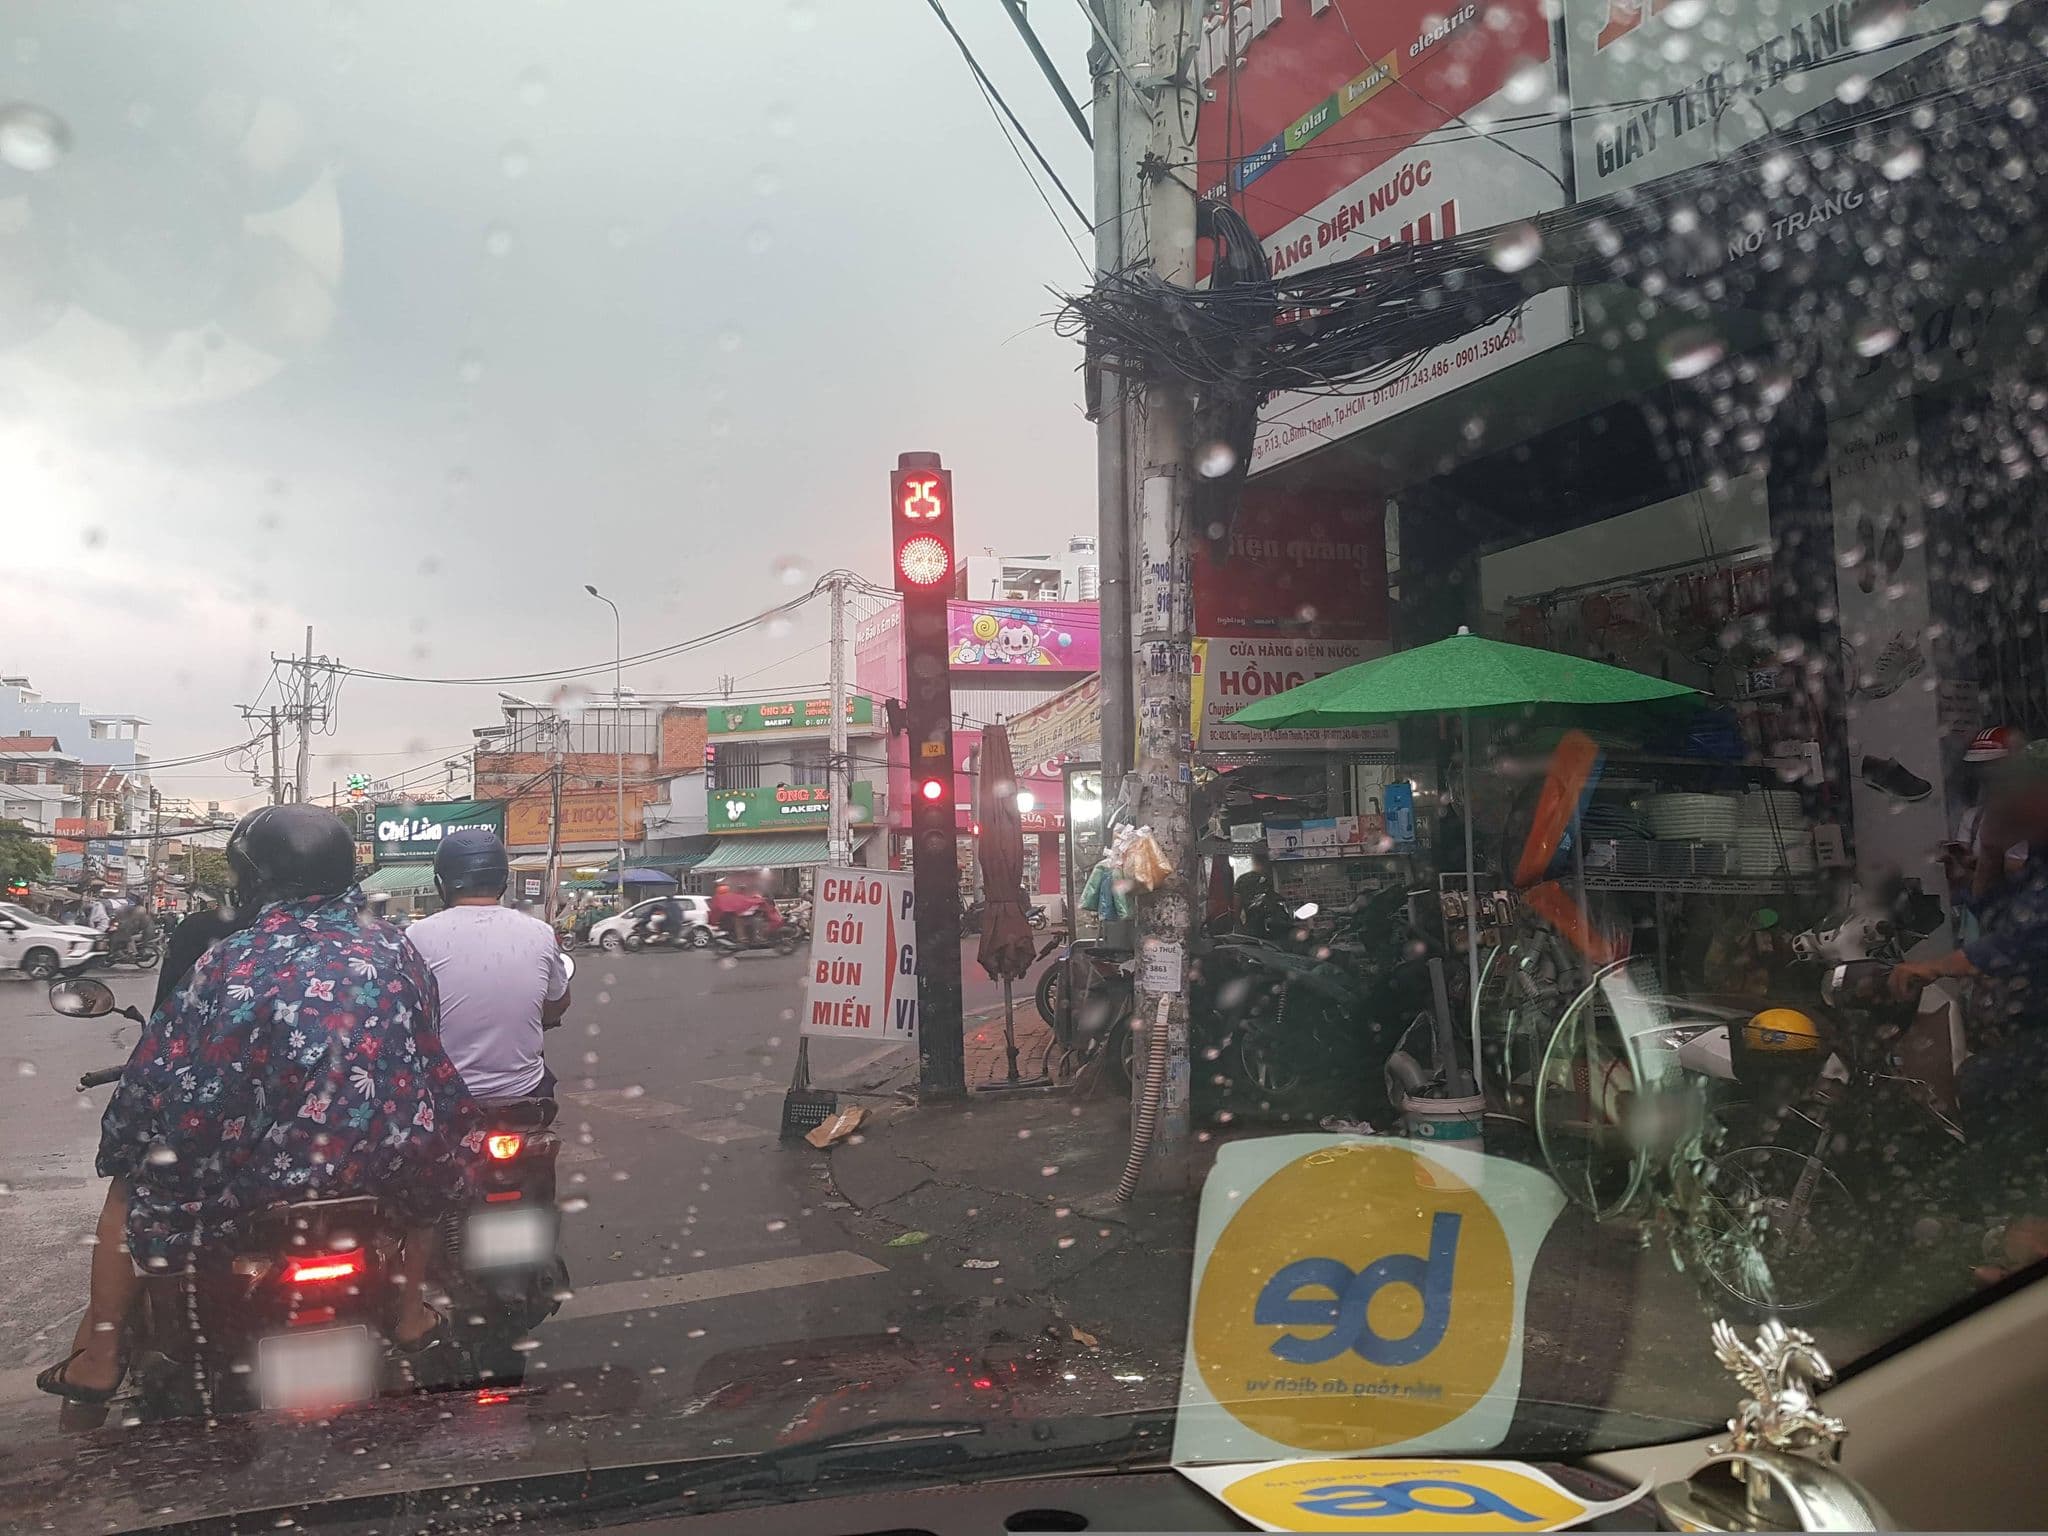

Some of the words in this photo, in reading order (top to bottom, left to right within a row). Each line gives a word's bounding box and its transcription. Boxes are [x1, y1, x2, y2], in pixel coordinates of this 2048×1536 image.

[1409, 3, 1475, 57] electric
[1293, 106, 1328, 141] solar
[1316, 200, 1366, 249] ĐIỆN
[1369, 160, 1433, 218] NƯỚC
[1772, 191, 1864, 241] TRANG
[1334, 397, 1366, 423] Tp.HCM
[1390, 358, 1449, 398] 0777.243.486
[904, 481, 941, 519] 25
[1258, 643, 1293, 657] HÀNG
[775, 787, 810, 803] ÔNG
[813, 788, 832, 801] X
[781, 804, 830, 814] BAKERY
[823, 876, 883, 906] CHÁO
[901, 889, 914, 921] P
[826, 913, 864, 945] GỎI
[900, 943, 914, 976] G
[815, 956, 863, 986] BÚN
[812, 995, 871, 1029] MIẾN
[896, 998, 916, 1038] VỊ
